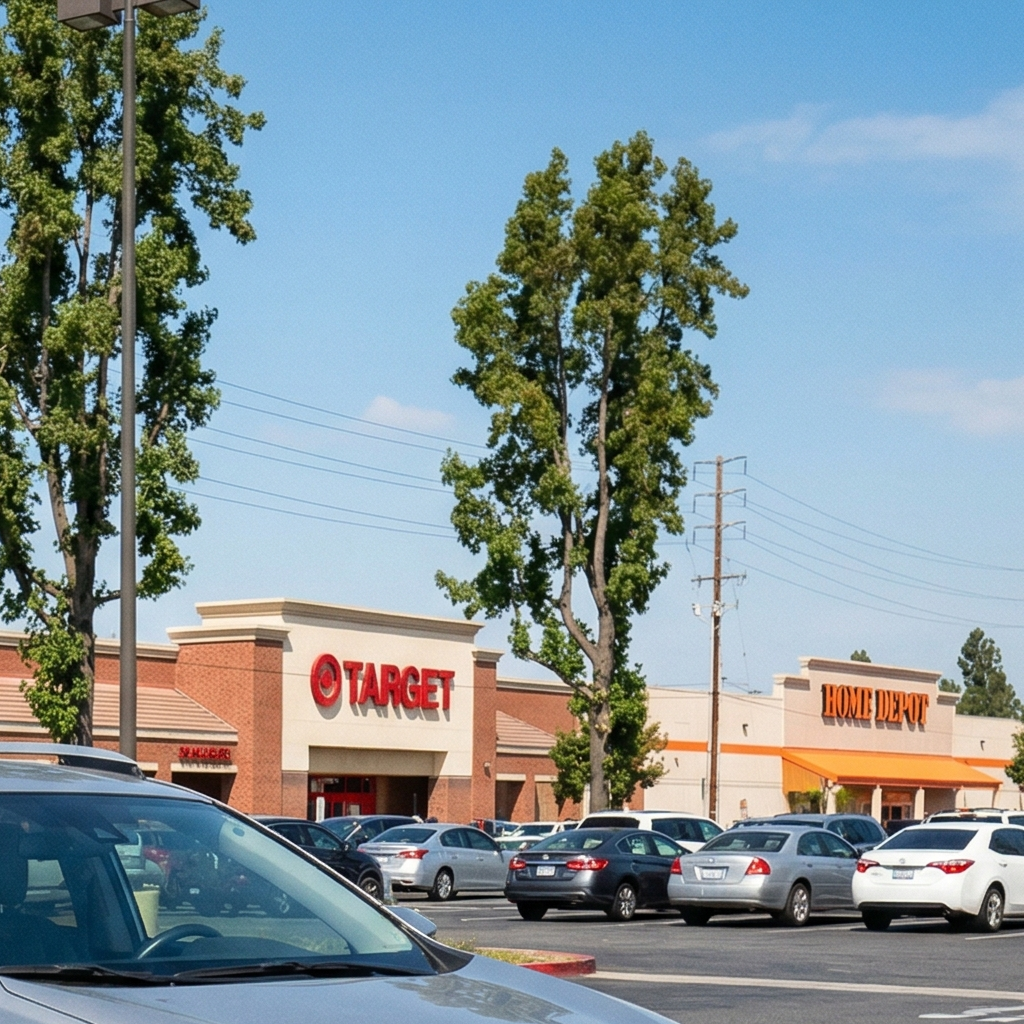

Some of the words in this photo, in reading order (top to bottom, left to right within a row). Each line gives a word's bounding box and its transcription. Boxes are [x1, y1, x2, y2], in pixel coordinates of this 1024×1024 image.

[343, 661, 455, 710] TARGET
[823, 684, 873, 719] HOME
[876, 689, 929, 725] DEPOT
